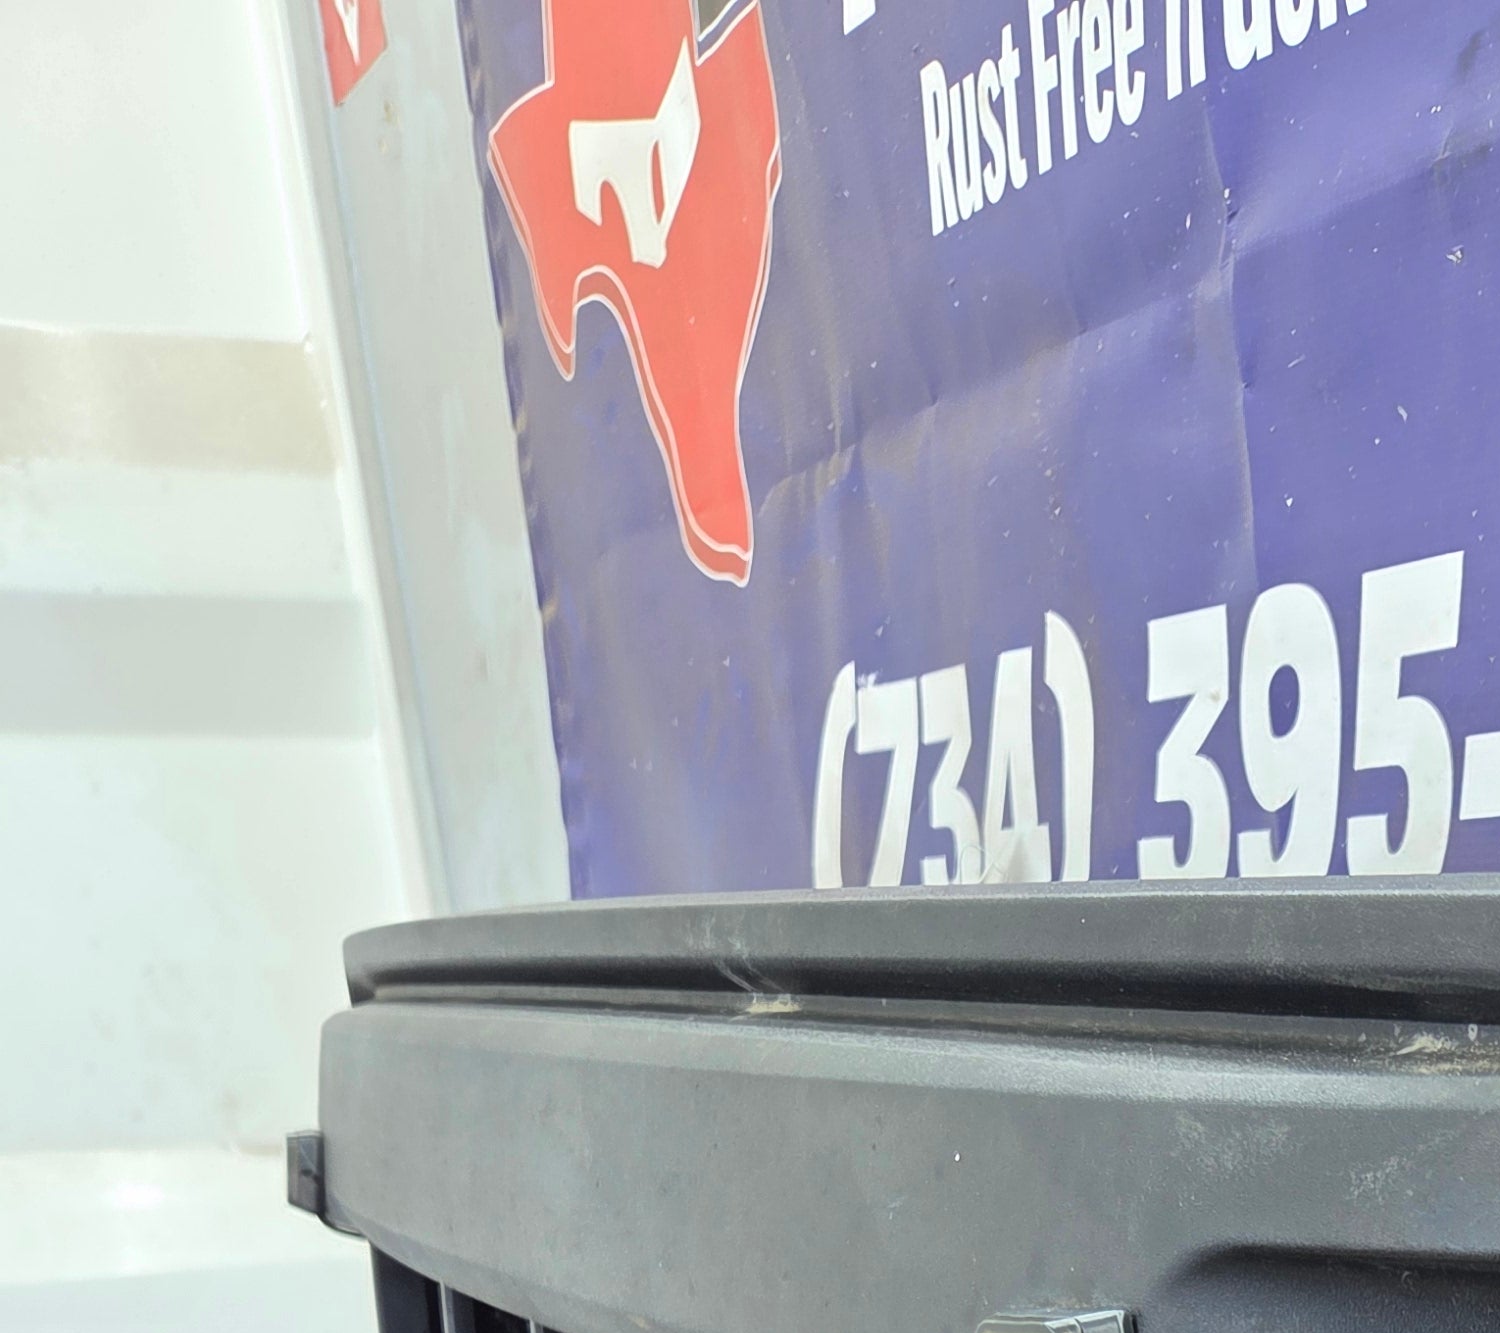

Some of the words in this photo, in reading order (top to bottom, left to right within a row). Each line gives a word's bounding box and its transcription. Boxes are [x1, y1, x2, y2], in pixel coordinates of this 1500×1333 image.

[919, 24, 1027, 236] Rust
[1027, 0, 1146, 175] Free
[811, 609, 1095, 889] (734)
